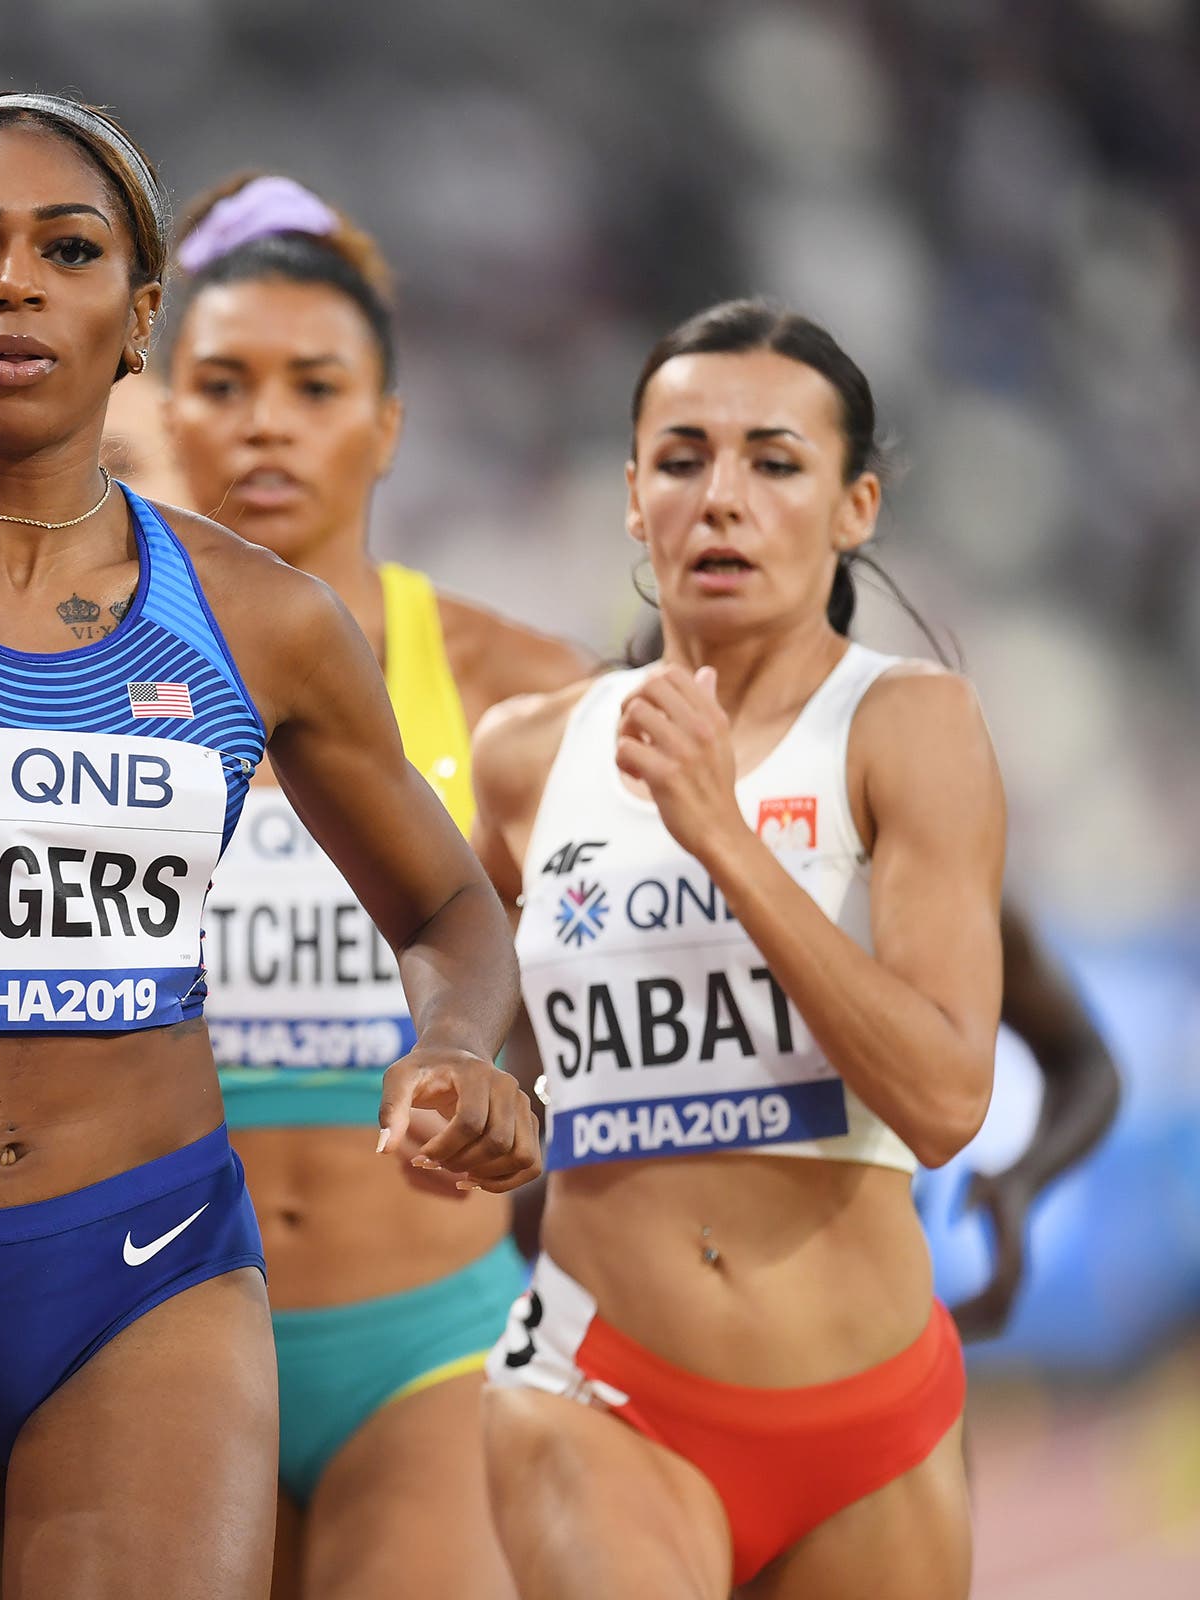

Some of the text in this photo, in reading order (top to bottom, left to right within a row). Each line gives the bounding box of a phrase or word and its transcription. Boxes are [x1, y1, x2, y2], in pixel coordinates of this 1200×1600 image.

[11, 747, 174, 809] QNB
[624, 875, 735, 932] QN
[545, 965, 796, 1079] SABAT
[572, 1093, 792, 1158] DOHA2019
[505, 1289, 544, 1369] 3
